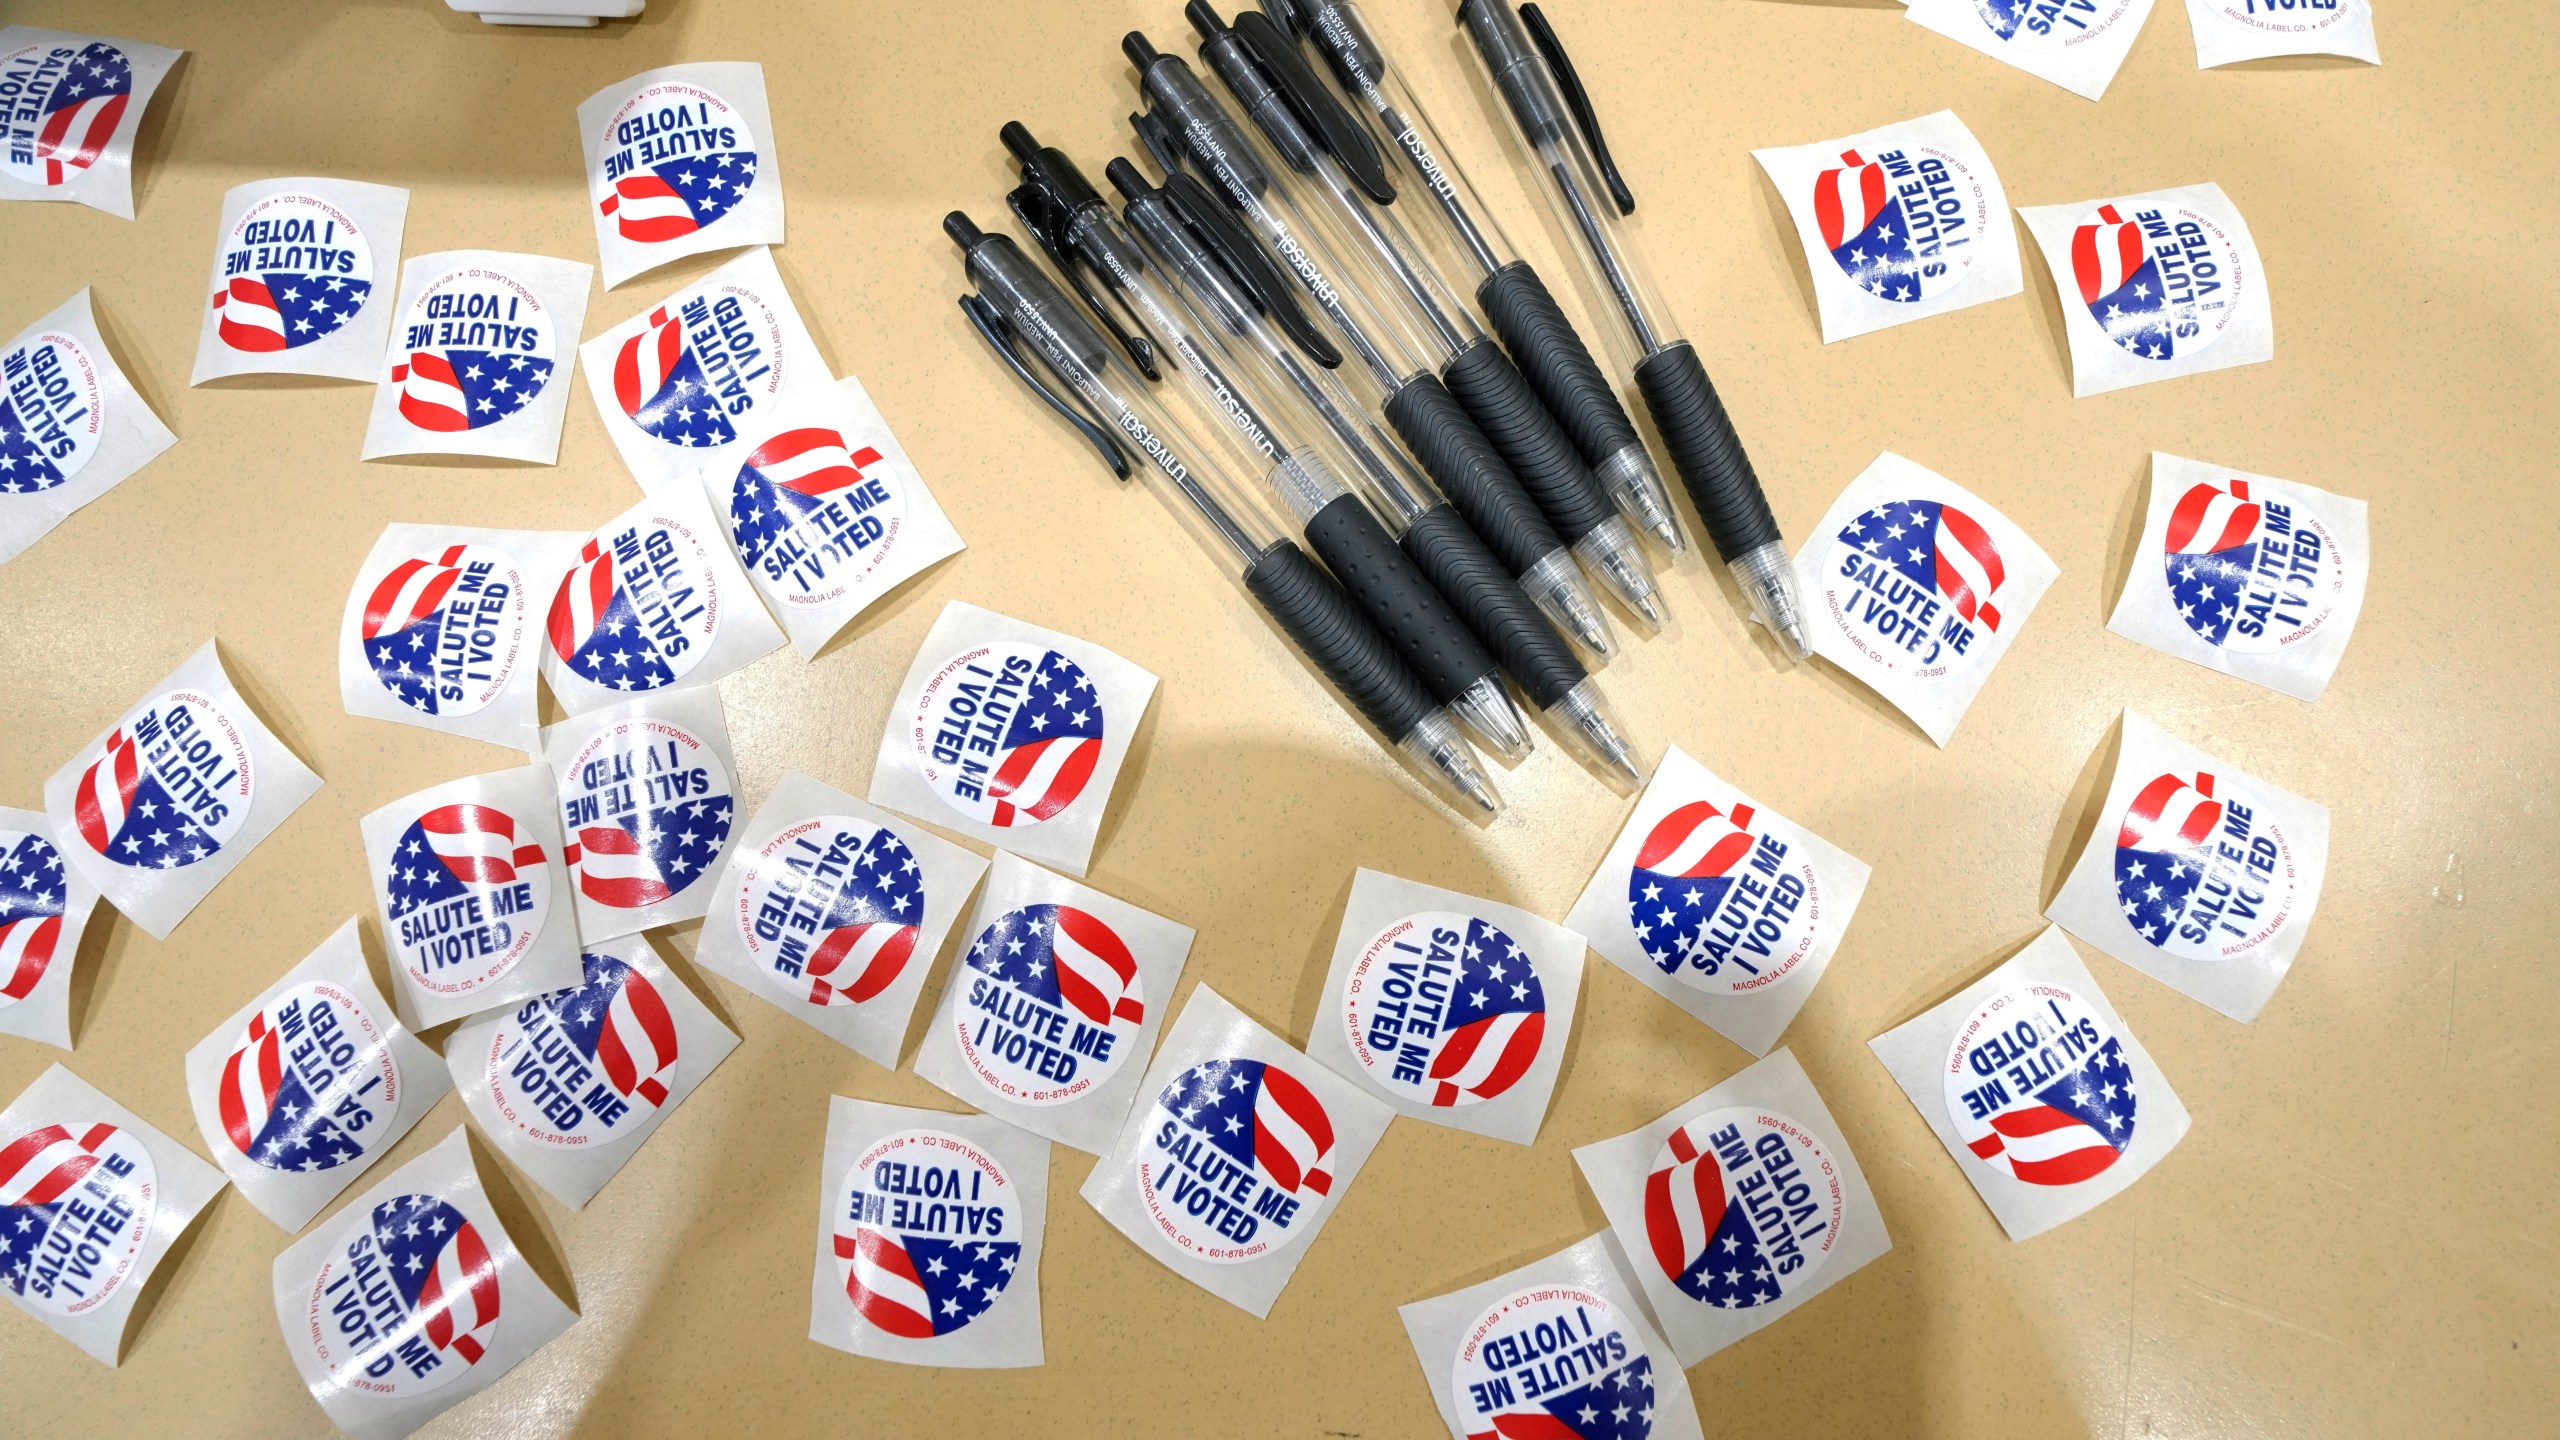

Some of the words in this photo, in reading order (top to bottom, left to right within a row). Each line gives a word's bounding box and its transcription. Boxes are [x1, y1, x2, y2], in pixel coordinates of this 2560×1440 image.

[1317, 14, 1343, 49] MEDIUM
[1326, 6, 1359, 50] UNV15530
[2224, 6, 2264, 28] MAGNOLIA
[2266, 23, 2292, 32] LABEL
[1343, 52, 1359, 72] PEN
[12, 47, 76, 124] SALUTE
[647, 87, 660, 96] CO.
[663, 86, 687, 94] LABEL
[689, 88, 728, 113] MAGNOLIA
[1354, 69, 1387, 113] BALLPOINT
[604, 100, 635, 141] 601-878-0951
[617, 104, 699, 146] VOTED
[699, 103, 708, 125] I
[10, 129, 36, 166] ME
[641, 127, 737, 166] SALUTE
[1184, 126, 1213, 161] MEDIUM
[604, 153, 634, 182] ME
[1213, 163, 1228, 182] PEN
[1397, 127, 1457, 200] universal
[1878, 150, 1915, 179] ME
[1226, 181, 1261, 223] BALLPOINT
[1917, 159, 1966, 234] VOTED
[244, 218, 315, 245] VOTED
[325, 220, 333, 245] I
[2135, 209, 2166, 240] ME
[225, 250, 252, 276] ME
[254, 245, 356, 273] SALUTE
[1103, 252, 1138, 292] UNV15530
[2174, 221, 2222, 296] VOTED
[484, 271, 506, 283] LABEL
[427, 293, 499, 320] VOTED
[507, 279, 541, 312] MAGNOLIA
[509, 294, 517, 321] I
[681, 295, 710, 329] ME
[1140, 294, 1164, 326] Medium
[713, 296, 761, 369] VOTED
[765, 310, 775, 323] CO.
[1013, 307, 1043, 341] MEDIUM
[406, 325, 432, 350] ME
[437, 322, 539, 351] SALUTE
[771, 324, 781, 349] LABEL
[1167, 328, 1182, 346] Pen
[4, 346, 26, 382] ME
[30, 344, 77, 415] VOTED
[692, 324, 753, 415] SALUTE
[745, 364, 771, 382] I
[768, 349, 783, 393] MAGNOLIA
[1060, 359, 1100, 402] BALLPOINT
[10, 373, 76, 460] SALUTE
[63, 406, 89, 426] I
[1211, 383, 1275, 459] universal
[1118, 410, 1188, 483] universal
[845, 478, 891, 515] ME
[2265, 500, 2292, 537] ME
[613, 526, 647, 566] ME
[457, 560, 495, 594] ME
[793, 569, 810, 593] I
[1840, 553, 1941, 627] SALUTE
[680, 603, 705, 625] I
[1844, 589, 1863, 613] I
[467, 582, 511, 668] VOTED
[2274, 612, 2302, 627] I
[440, 600, 475, 702] SALUTE
[467, 671, 492, 682] I
[966, 664, 994, 678] I
[932, 683, 987, 765] VOTED
[968, 655, 1033, 757] SALUTE
[134, 708, 163, 749] ME
[164, 704, 223, 780] VOTED
[667, 741, 680, 768] I
[147, 738, 229, 828] SALUTE
[212, 769, 237, 791] I
[954, 765, 990, 802] ME
[566, 796, 599, 829] ME
[2223, 799, 2253, 842] ME
[793, 837, 822, 856] I
[1691, 873, 1768, 976] SALUTE
[1750, 833, 1788, 878] ME
[1802, 864, 1818, 920] 601-878-0951
[401, 895, 484, 947] SALUTE
[1742, 873, 1806, 957] VOTED
[2220, 921, 2248, 939] I
[1372, 920, 1414, 953] MAGNOLIA
[1393, 941, 1423, 955] I
[1800, 937, 1812, 952] CO.
[421, 946, 428, 974] I
[774, 939, 809, 979] ME
[1355, 950, 1376, 978] LABEL
[1732, 955, 1759, 976] I
[1779, 952, 1804, 974] LABEL
[1350, 979, 1362, 995] CO.
[1406, 927, 1460, 1040] SALUTE
[1733, 970, 1780, 992] MAGNOLIA
[278, 998, 305, 1044] ME
[968, 976, 1071, 1045] SALUTE
[1069, 1021, 1117, 1063] ME
[1367, 962, 1416, 1052] VOTED
[2047, 999, 2067, 1026] I
[974, 1017, 990, 1047] I
[992, 1023, 1078, 1084] VOTED
[1348, 1012, 1374, 1067] 601-878-0951
[958, 1023, 980, 1068] MAGNOLIA
[978, 1065, 1000, 1088] LABEL
[1001, 1083, 1016, 1096] CO.
[1034, 1078, 1090, 1100] 601-878-0951
[1392, 1042, 1430, 1086] ME
[356, 1075, 382, 1096] I
[511, 1050, 583, 1131] VOTED
[1960, 1079, 2012, 1120] ME
[581, 1082, 630, 1128] ME
[921, 1136, 937, 1146] CO.
[939, 1138, 967, 1157] LABEL
[1709, 1122, 1754, 1172] ME
[1757, 1115, 1813, 1148] 601-878-0951
[859, 1138, 904, 1170] 601-878-0951
[967, 1149, 1005, 1187] MAGNOLIA
[1821, 1158, 1832, 1175] CO.
[874, 1160, 961, 1200] VOTED
[971, 1170, 981, 1200] I
[1156, 1120, 1258, 1204] SALUTE
[1252, 1186, 1300, 1229] ME
[1754, 1132, 1820, 1226] VOTED
[1829, 1176, 1842, 1204] LABEL
[892, 1199, 1004, 1236] SALUTE
[1140, 1163, 1159, 1215] MAGNOLIA
[1155, 1213, 1178, 1239] LABEL
[1177, 1235, 1192, 1249] CO.
[1209, 1242, 1268, 1258] 601-878-0951
[1154, 1163, 1176, 1191] I
[1171, 1173, 1259, 1244] VOTED
[1736, 1170, 1805, 1276] SALUTE
[1800, 1221, 1827, 1241] I
[1821, 1206, 1842, 1251] MAGNOLIA
[31, 1197, 96, 1299] SALUTE
[61, 1278, 84, 1298] I
[324, 1274, 350, 1296] I
[1576, 1306, 1593, 1337] I
[395, 1334, 442, 1379] ME
[1483, 1315, 1579, 1372] VOTED
[1518, 1330, 1627, 1400] SALUTE
[1469, 1376, 1516, 1413] ME
